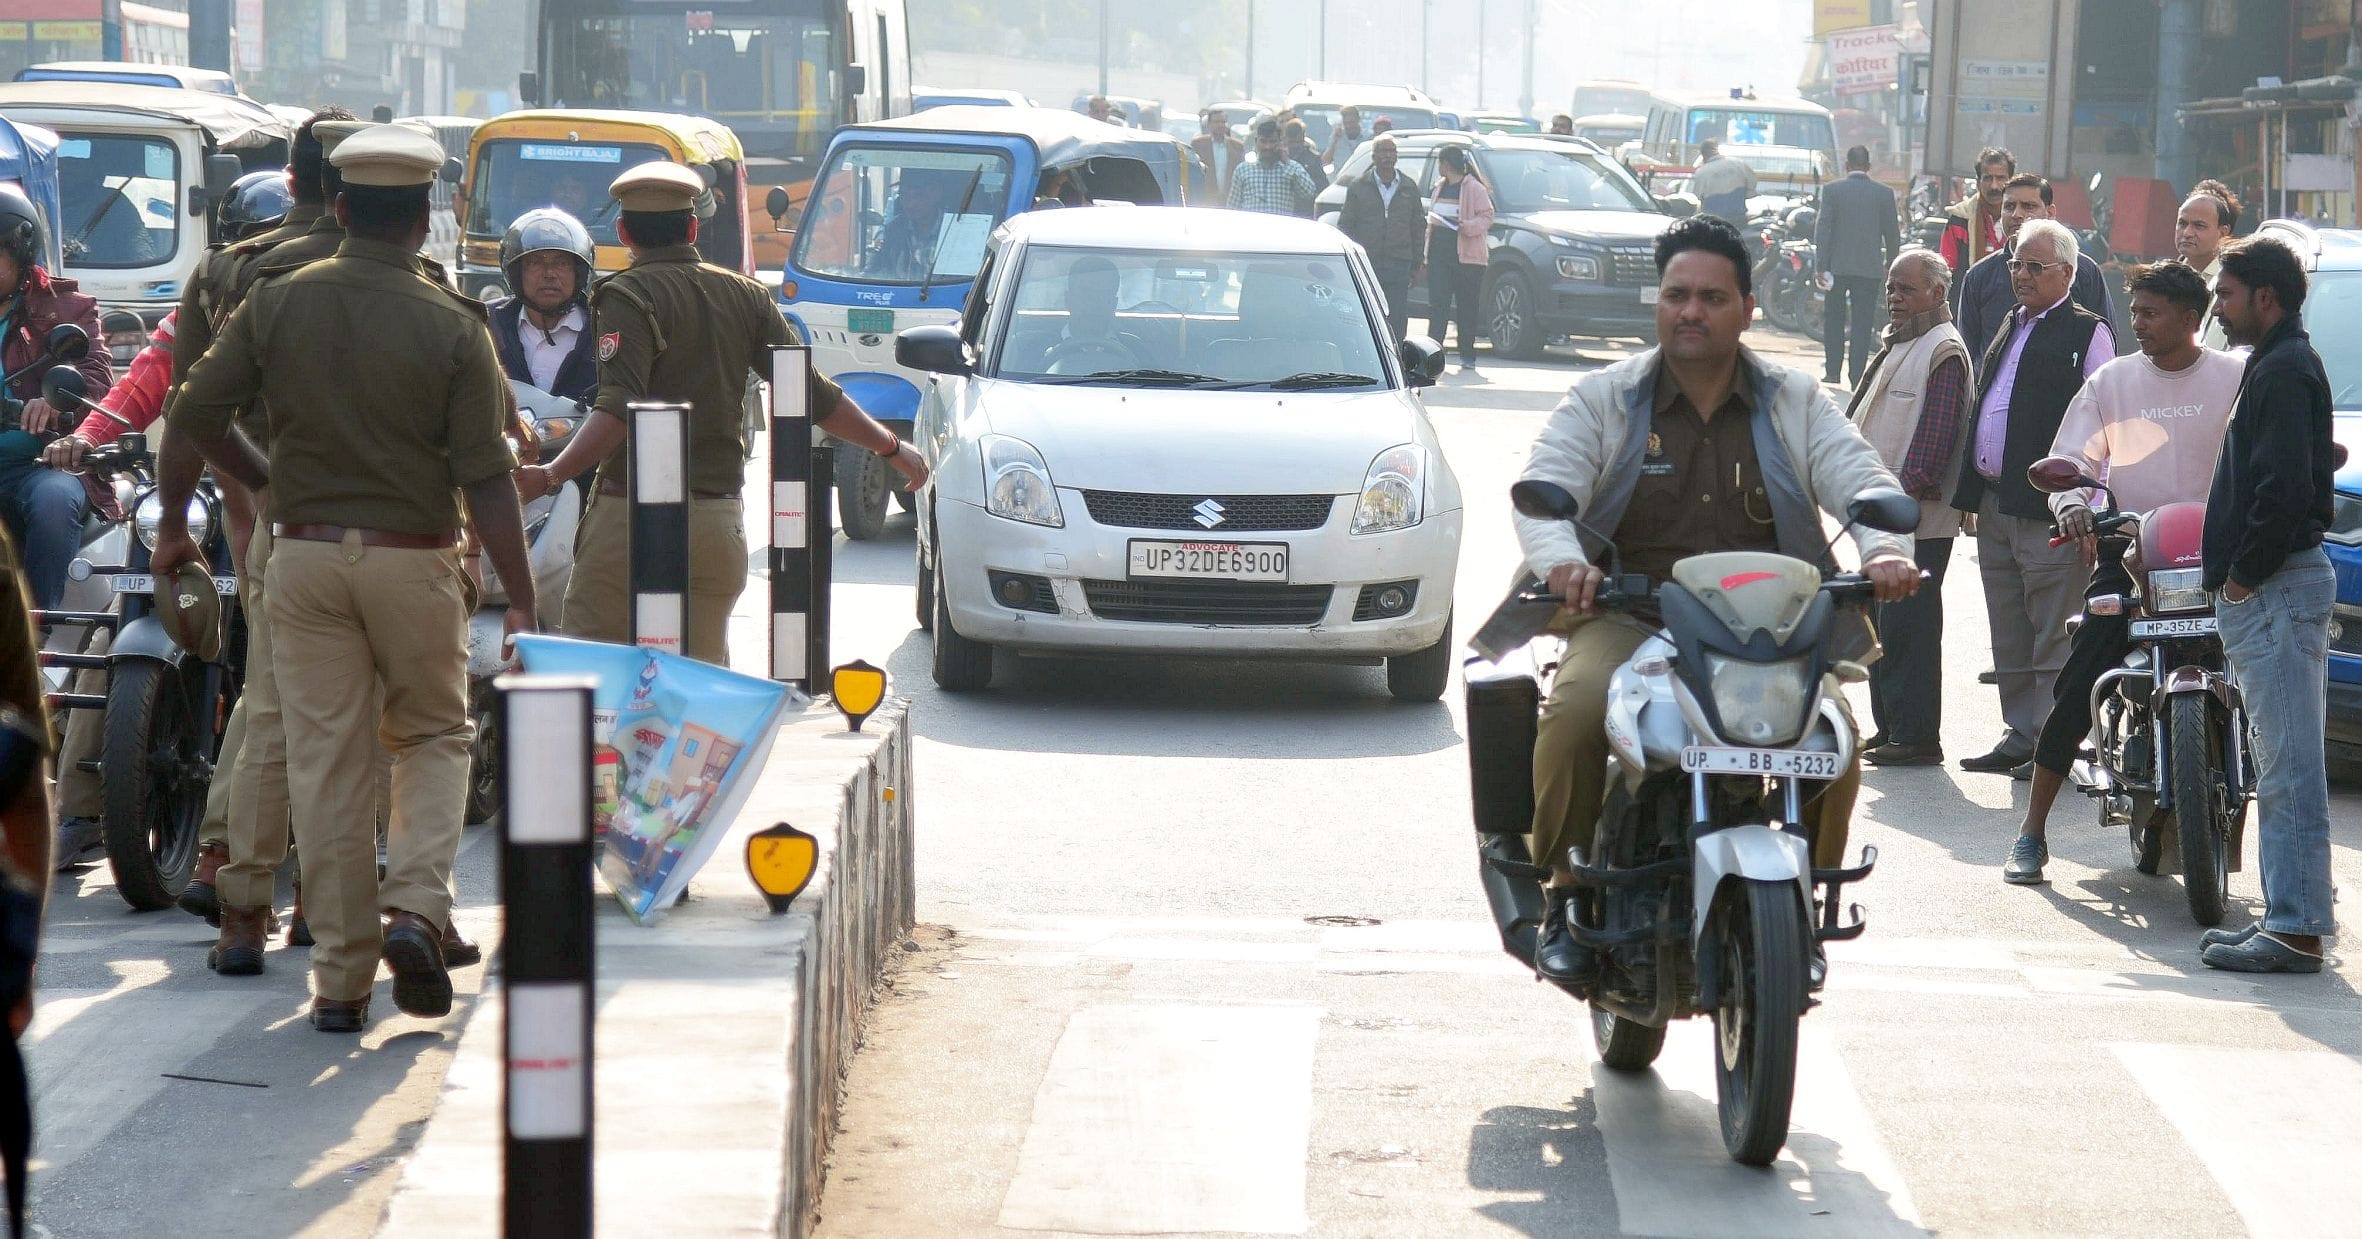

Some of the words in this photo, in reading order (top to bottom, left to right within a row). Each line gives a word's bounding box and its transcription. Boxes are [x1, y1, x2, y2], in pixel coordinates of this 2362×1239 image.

[537, 147, 580, 158] BRIGHT
[581, 149, 618, 160] BAJAJ
[2140, 404, 2204, 420] MICKEY
[1181, 543, 1239, 552] ADVOCATE
[1146, 548, 1285, 574] UP32DE6900
[128, 578, 146, 590] UP
[1793, 756, 1836, 776] 5232
